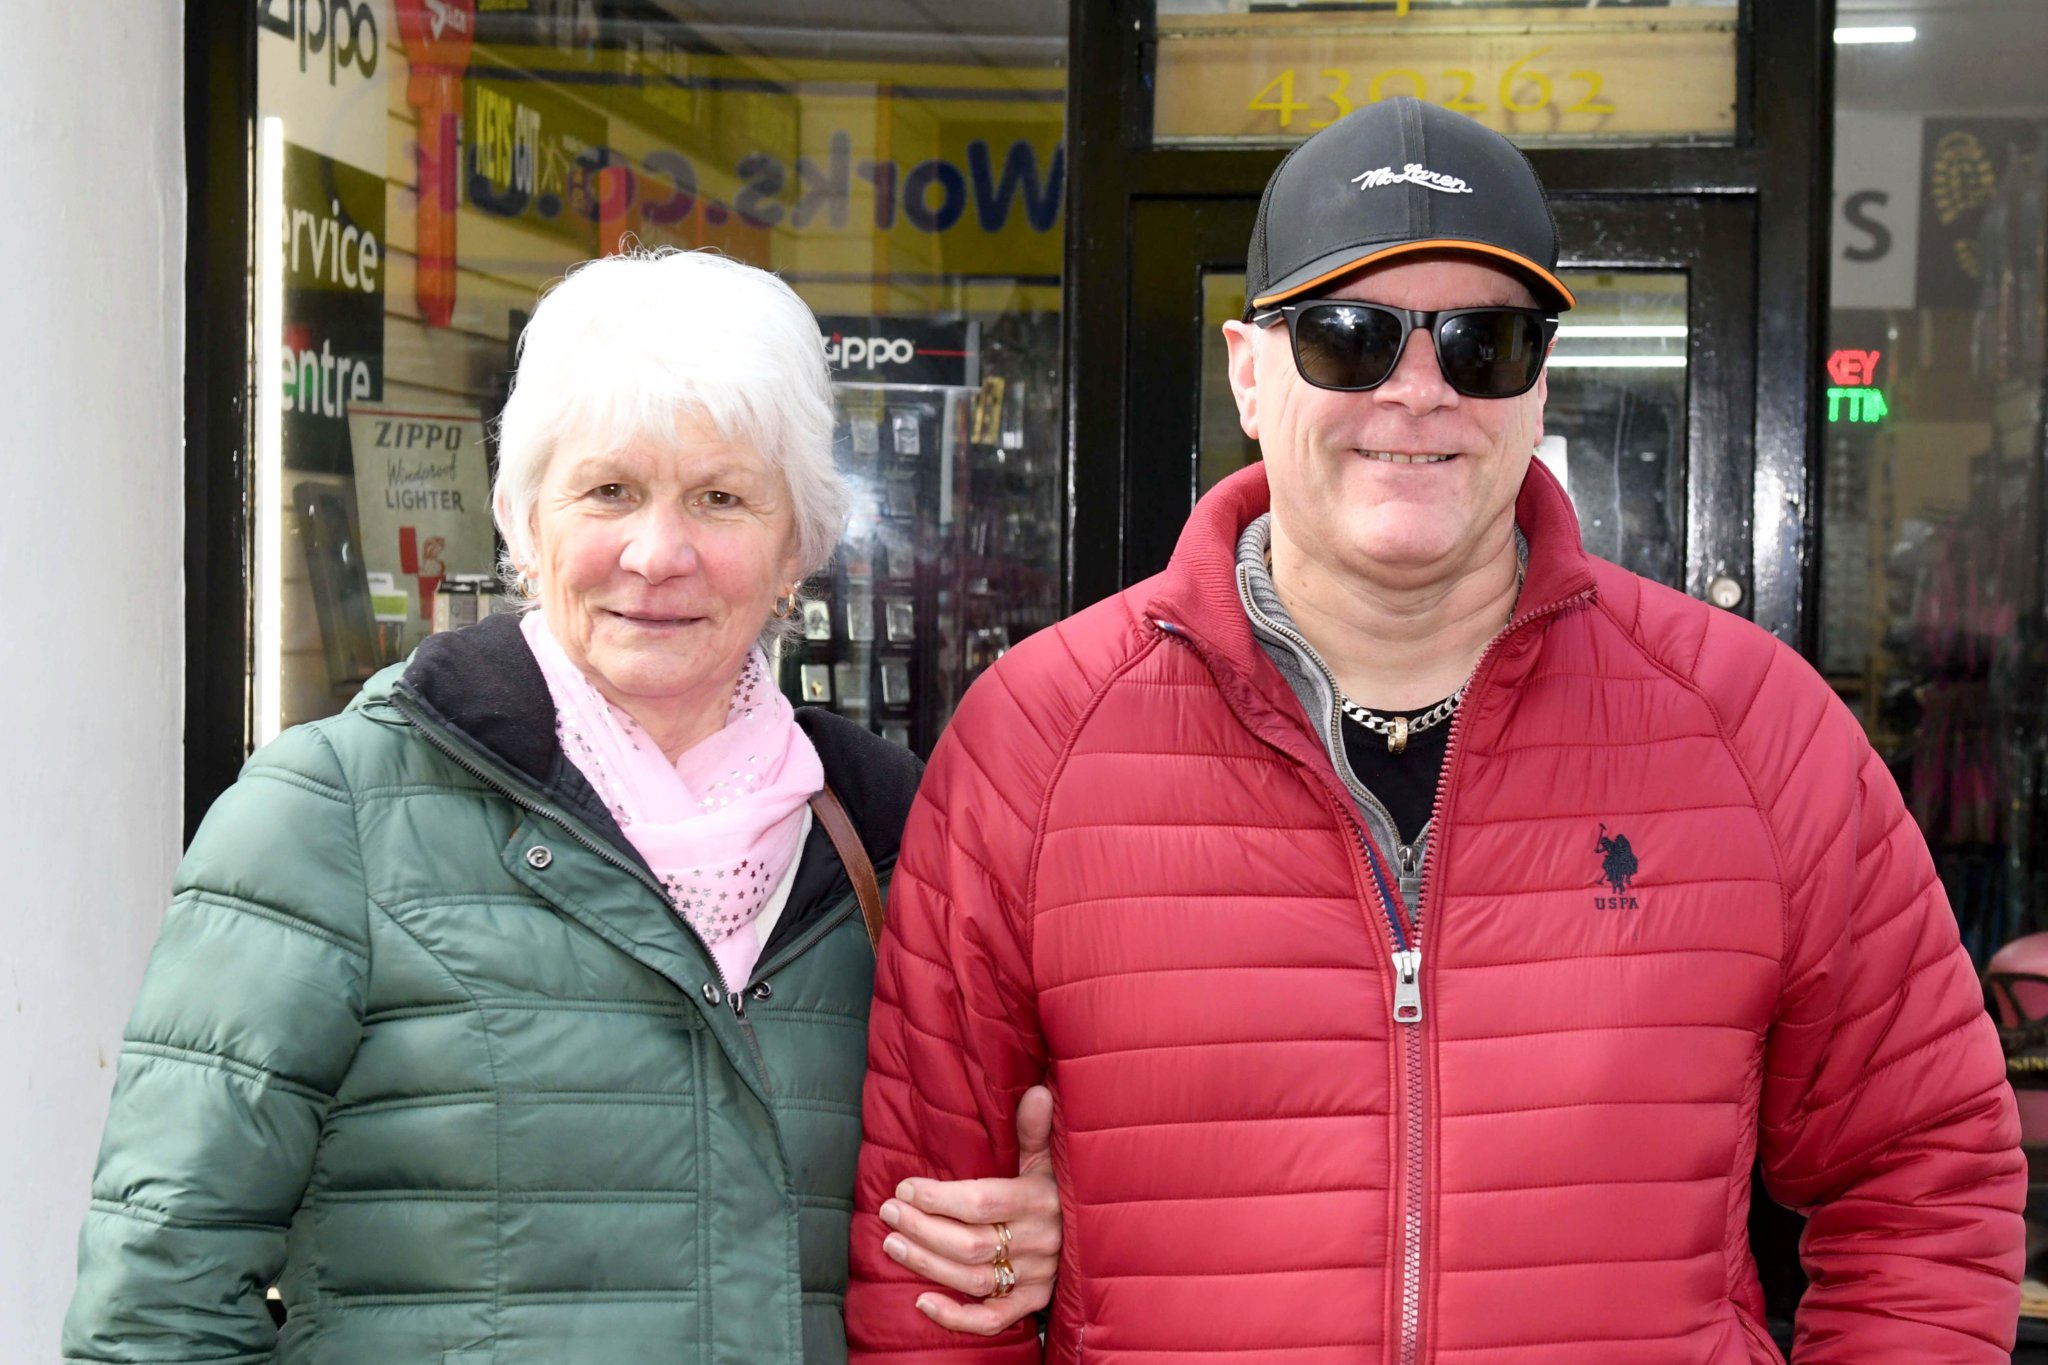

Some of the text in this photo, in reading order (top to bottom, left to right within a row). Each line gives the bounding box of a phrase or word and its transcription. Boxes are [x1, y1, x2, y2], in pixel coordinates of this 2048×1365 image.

[1247, 45, 1617, 130] 430262
[476, 85, 541, 197] KEYS CUT
[375, 421, 462, 450] ZIPPO
[385, 489, 464, 513] LIGHTER
[1595, 897, 1639, 910] USPA
